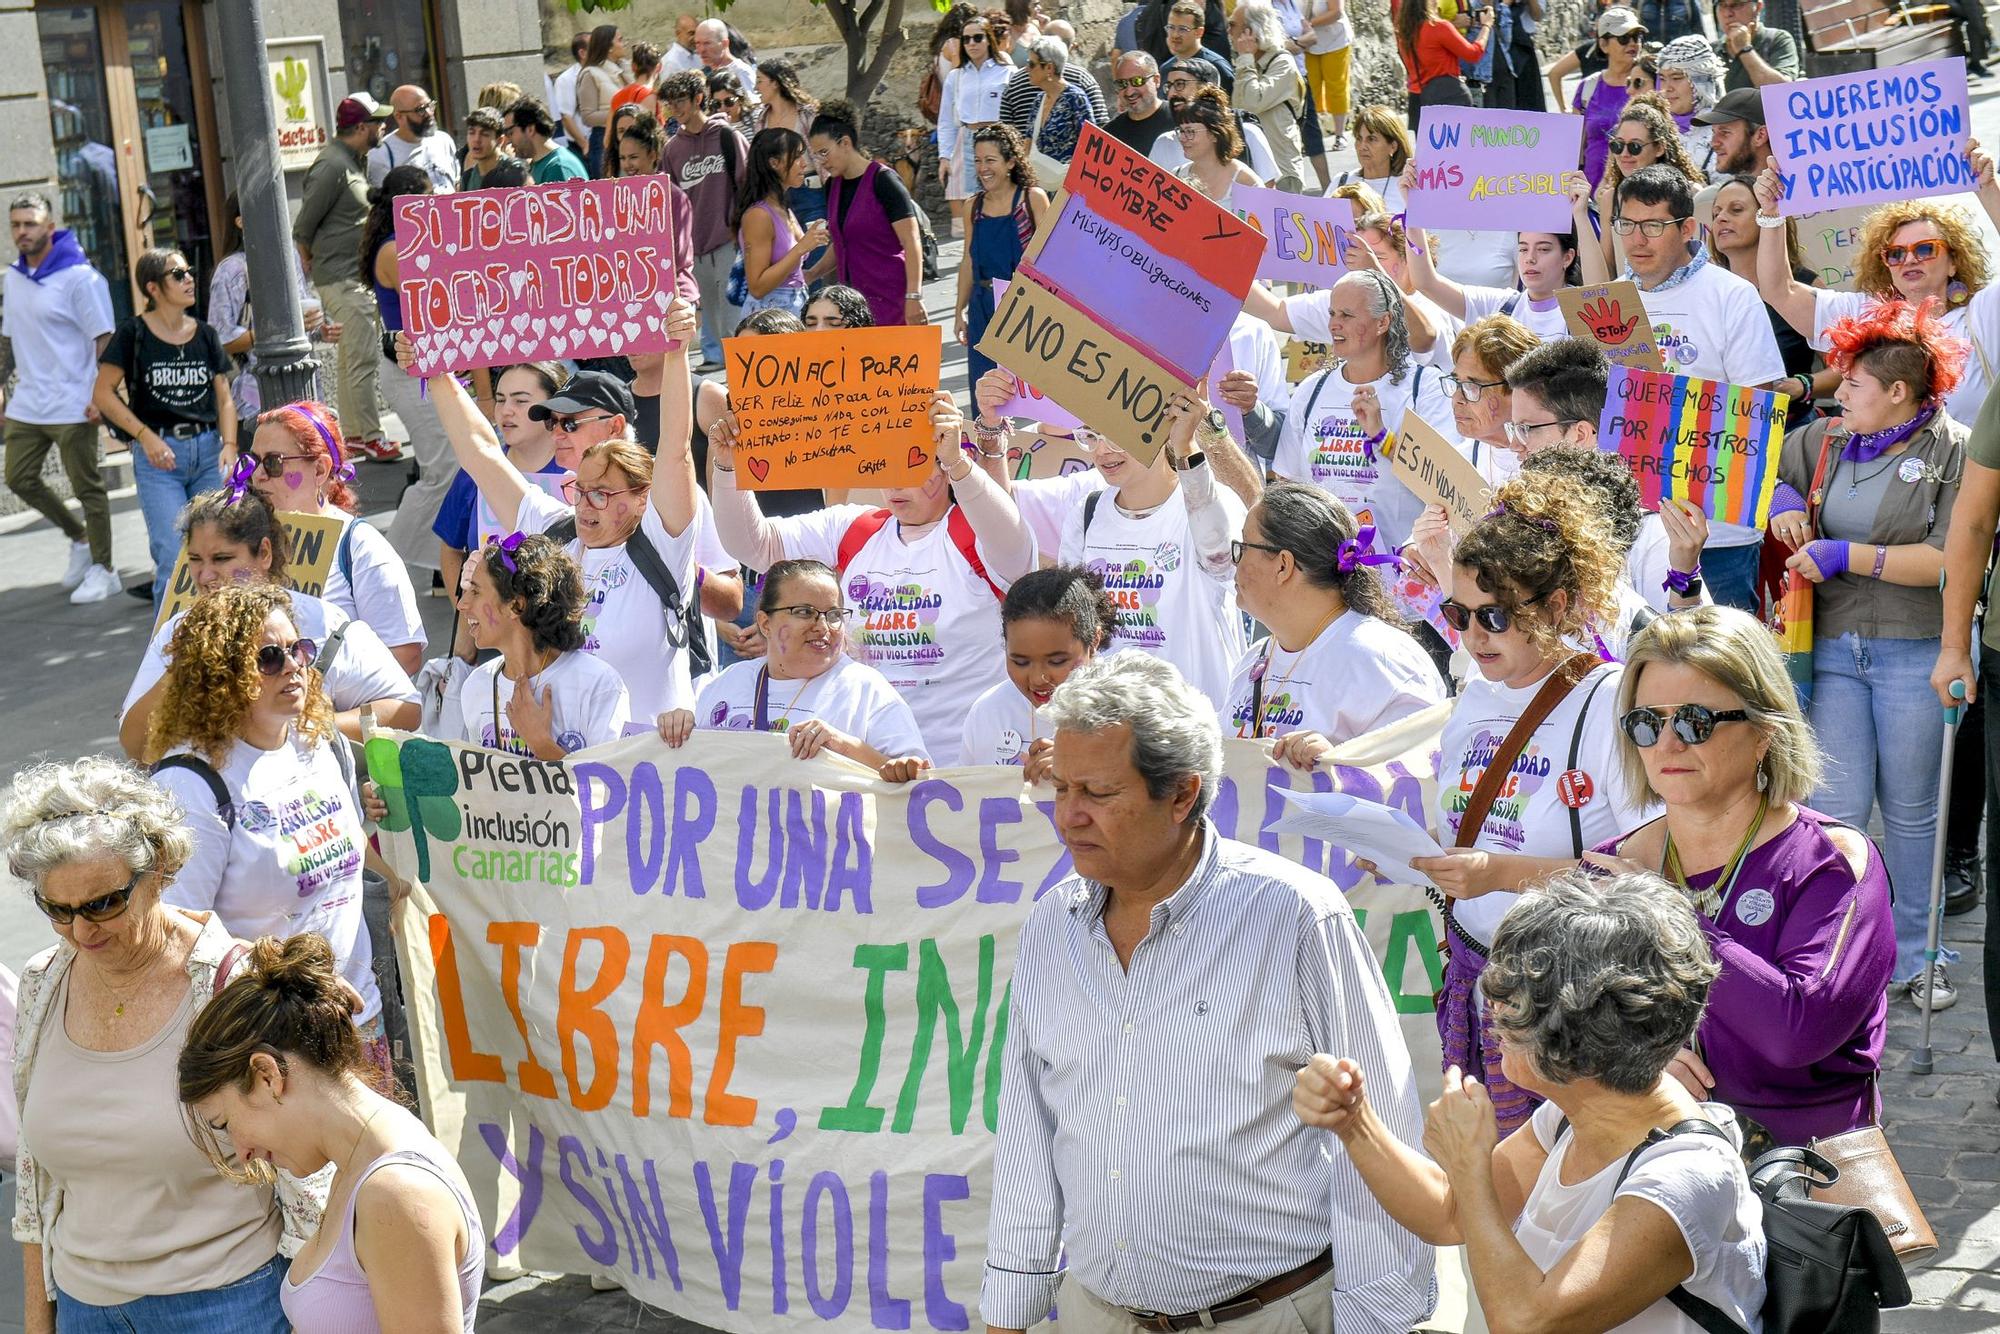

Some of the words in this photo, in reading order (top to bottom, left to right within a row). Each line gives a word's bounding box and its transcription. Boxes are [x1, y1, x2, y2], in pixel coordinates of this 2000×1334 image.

[1788, 71, 1941, 120] QUEREMOS
[278, 125, 325, 146] actu's
[1429, 122, 1461, 150] UN
[1470, 124, 1540, 148] MUNDO
[1085, 134, 1193, 212] MUJERES
[1417, 160, 1464, 191] MÁS
[1468, 172, 1573, 201] ACCESIBLE
[452, 189, 576, 251] TOCAS
[612, 180, 666, 236] UNA
[1080, 161, 1174, 232] HOMBRE
[1202, 213, 1241, 241] Y
[1273, 207, 1314, 263] ES
[401, 263, 510, 335] TOCAS
[524, 260, 544, 312] A
[994, 286, 1065, 362] ¡NO
[1066, 339, 1112, 384] ES
[152, 366, 208, 387] BRUJAS
[734, 394, 764, 414] SER
[811, 388, 830, 408] NO
[1617, 377, 1723, 413] QUEREMOS
[1731, 398, 1786, 430] LUCHAR
[805, 428, 822, 443] NO
[829, 423, 851, 441] TE
[1318, 438, 1362, 454] LIBRE
[1608, 416, 1648, 441] POR
[1659, 425, 1760, 457] NUESTROS
[784, 450, 798, 468] NO
[1318, 468, 1332, 478] SIN
[1333, 468, 1379, 480] VIOLENCIAS
[1396, 431, 1421, 472] ES
[1420, 456, 1434, 486] MI
[1435, 469, 1456, 506] VIDA
[1105, 562, 1122, 573] POR
[1124, 562, 1140, 572] UNA
[895, 585, 916, 596] UNA
[864, 611, 918, 631] LIBRE
[885, 647, 945, 661] VIOLENCIAS
[1487, 735, 1504, 747] POR
[460, 750, 575, 796] Plena
[464, 803, 570, 849] inclusión
[578, 761, 718, 900] POR
[735, 782, 874, 915] UNA
[307, 872, 324, 886] SIN
[478, 1122, 545, 1257] Y
